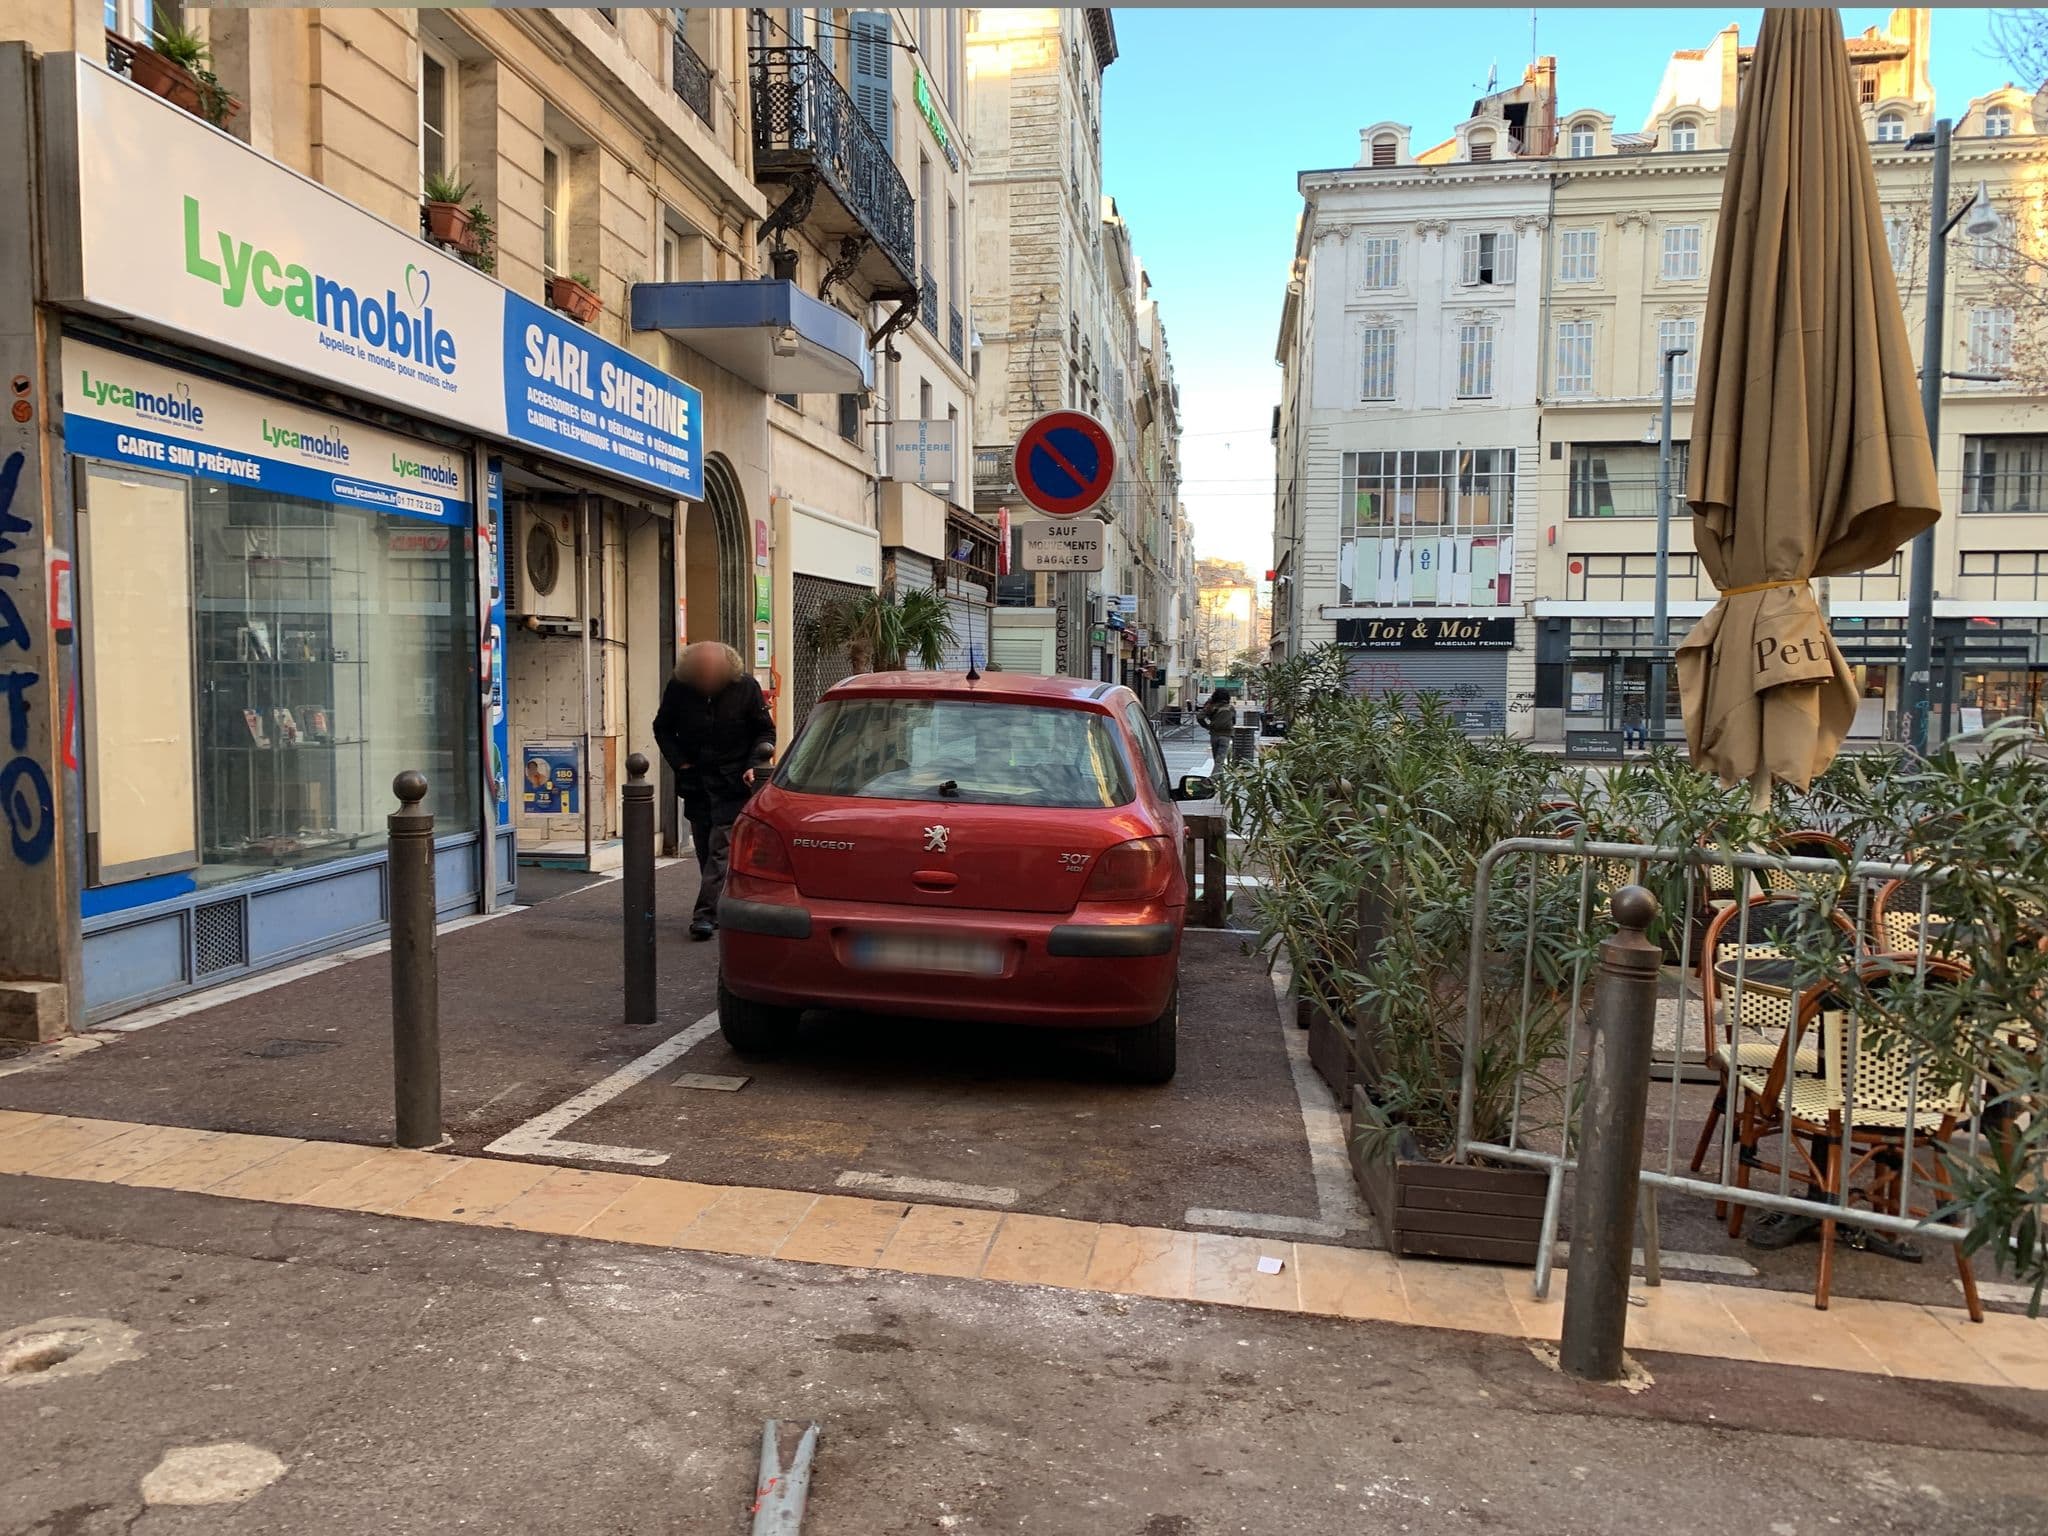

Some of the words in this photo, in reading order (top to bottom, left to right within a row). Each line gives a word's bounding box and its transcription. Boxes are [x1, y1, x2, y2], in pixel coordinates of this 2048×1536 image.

[184, 194, 457, 374] Lycamobile
[319, 331, 355, 356] Appelez
[358, 345, 365, 359] le
[368, 352, 395, 371] monde
[398, 363, 415, 377] pour
[418, 370, 440, 387] moins
[441, 378, 458, 393] cher
[82, 370, 203, 425] Lycamobile
[525, 324, 593, 400] SARL
[600, 361, 688, 441] SHERINE
[262, 419, 350, 460] Lycamobile
[527, 387, 579, 420] ACCESSOIRES
[580, 407, 597, 427] GSM
[608, 417, 644, 445] DÉBLOCAGE
[654, 437, 688, 462] RÉPARATION
[117, 434, 165, 461] CARTE
[169, 445, 194, 467] SIM
[198, 452, 261, 480] PRÉPAYÉE
[527, 409, 558, 433] CABINE
[558, 417, 610, 451] TÉLÉPHONIQUE
[619, 443, 648, 465] INTERNET
[656, 457, 690, 480] PHOTOCOPIE
[896, 444, 951, 452] MERCERIE
[919, 421, 927, 480] MERCERIE
[392, 453, 458, 486] Lycamobile
[336, 484, 396, 505] www.lycamobile.fr
[406, 497, 414, 507] 77
[415, 499, 424, 509] 72
[433, 503, 441, 513] 22
[1028, 541, 1097, 550] MOUVEMENTS
[1049, 527, 1077, 536] SAUF
[1036, 555, 1088, 564] BAGAGES
[1368, 621, 1405, 639] Toi
[1411, 622, 1429, 638] &
[1437, 621, 1482, 638] Moi
[793, 838, 855, 851] PEUGEOT
[1057, 853, 1091, 865] 307
